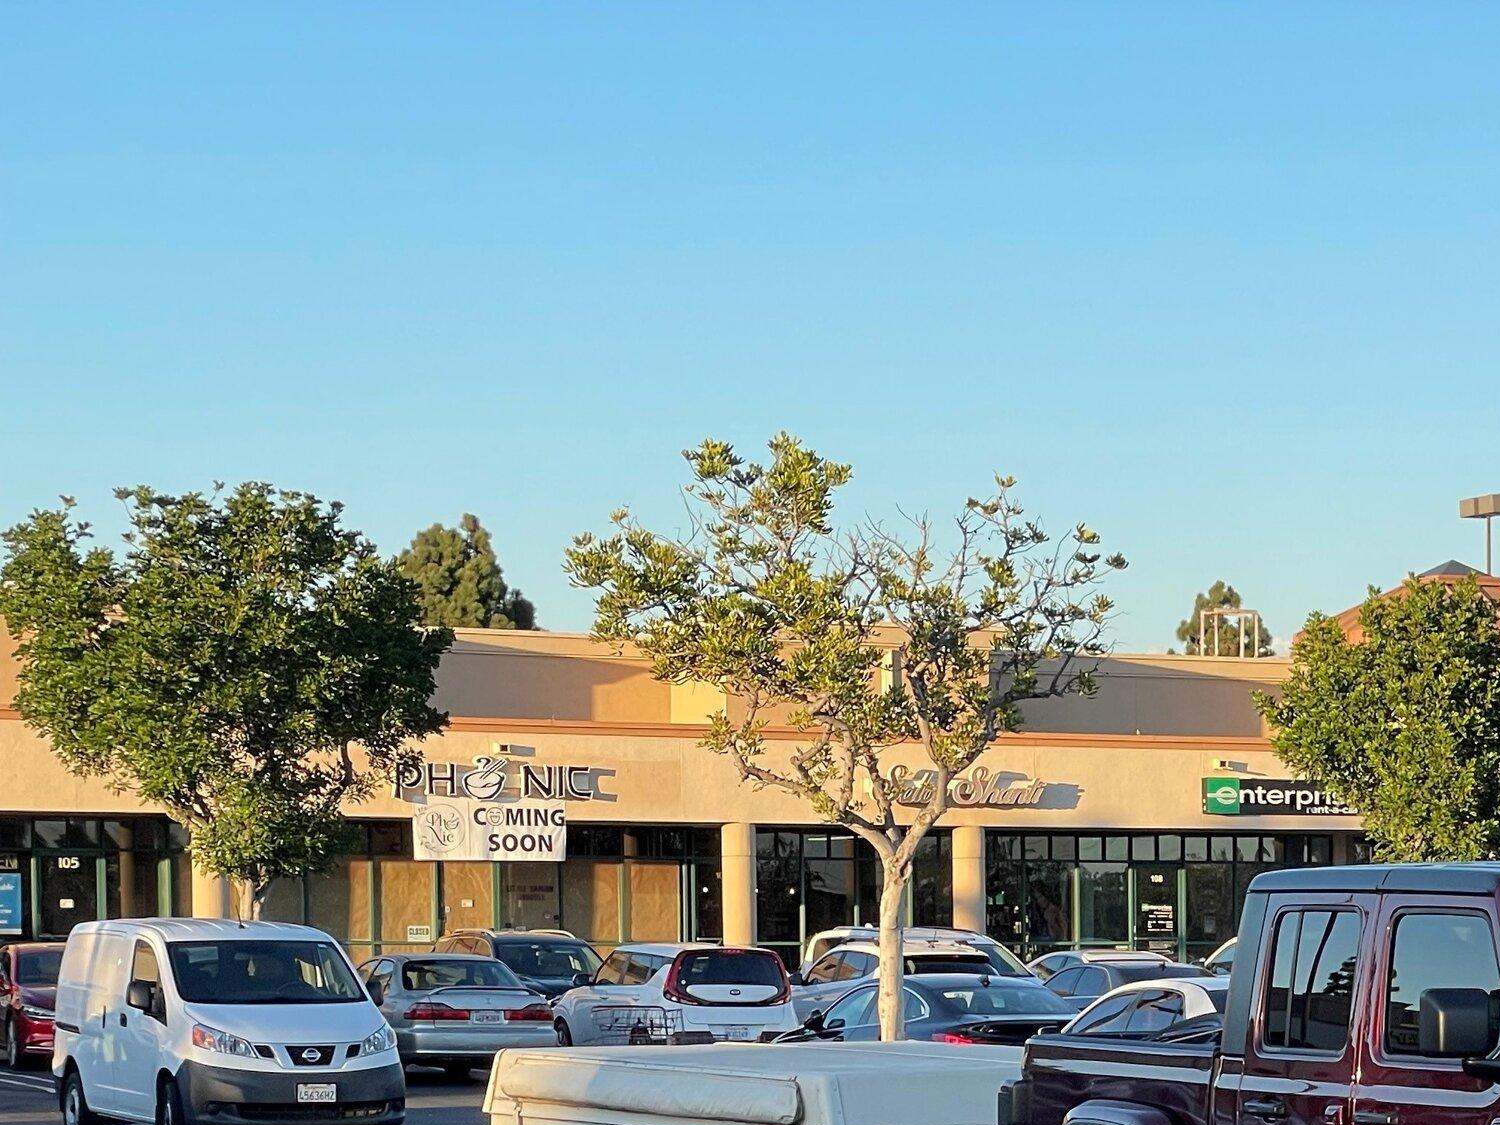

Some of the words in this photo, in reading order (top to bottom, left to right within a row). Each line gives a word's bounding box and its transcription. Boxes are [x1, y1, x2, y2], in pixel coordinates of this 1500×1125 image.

[950, 766, 1046, 805] Shanti
[488, 833, 553, 852] SOON
[58, 857, 80, 869] 105
